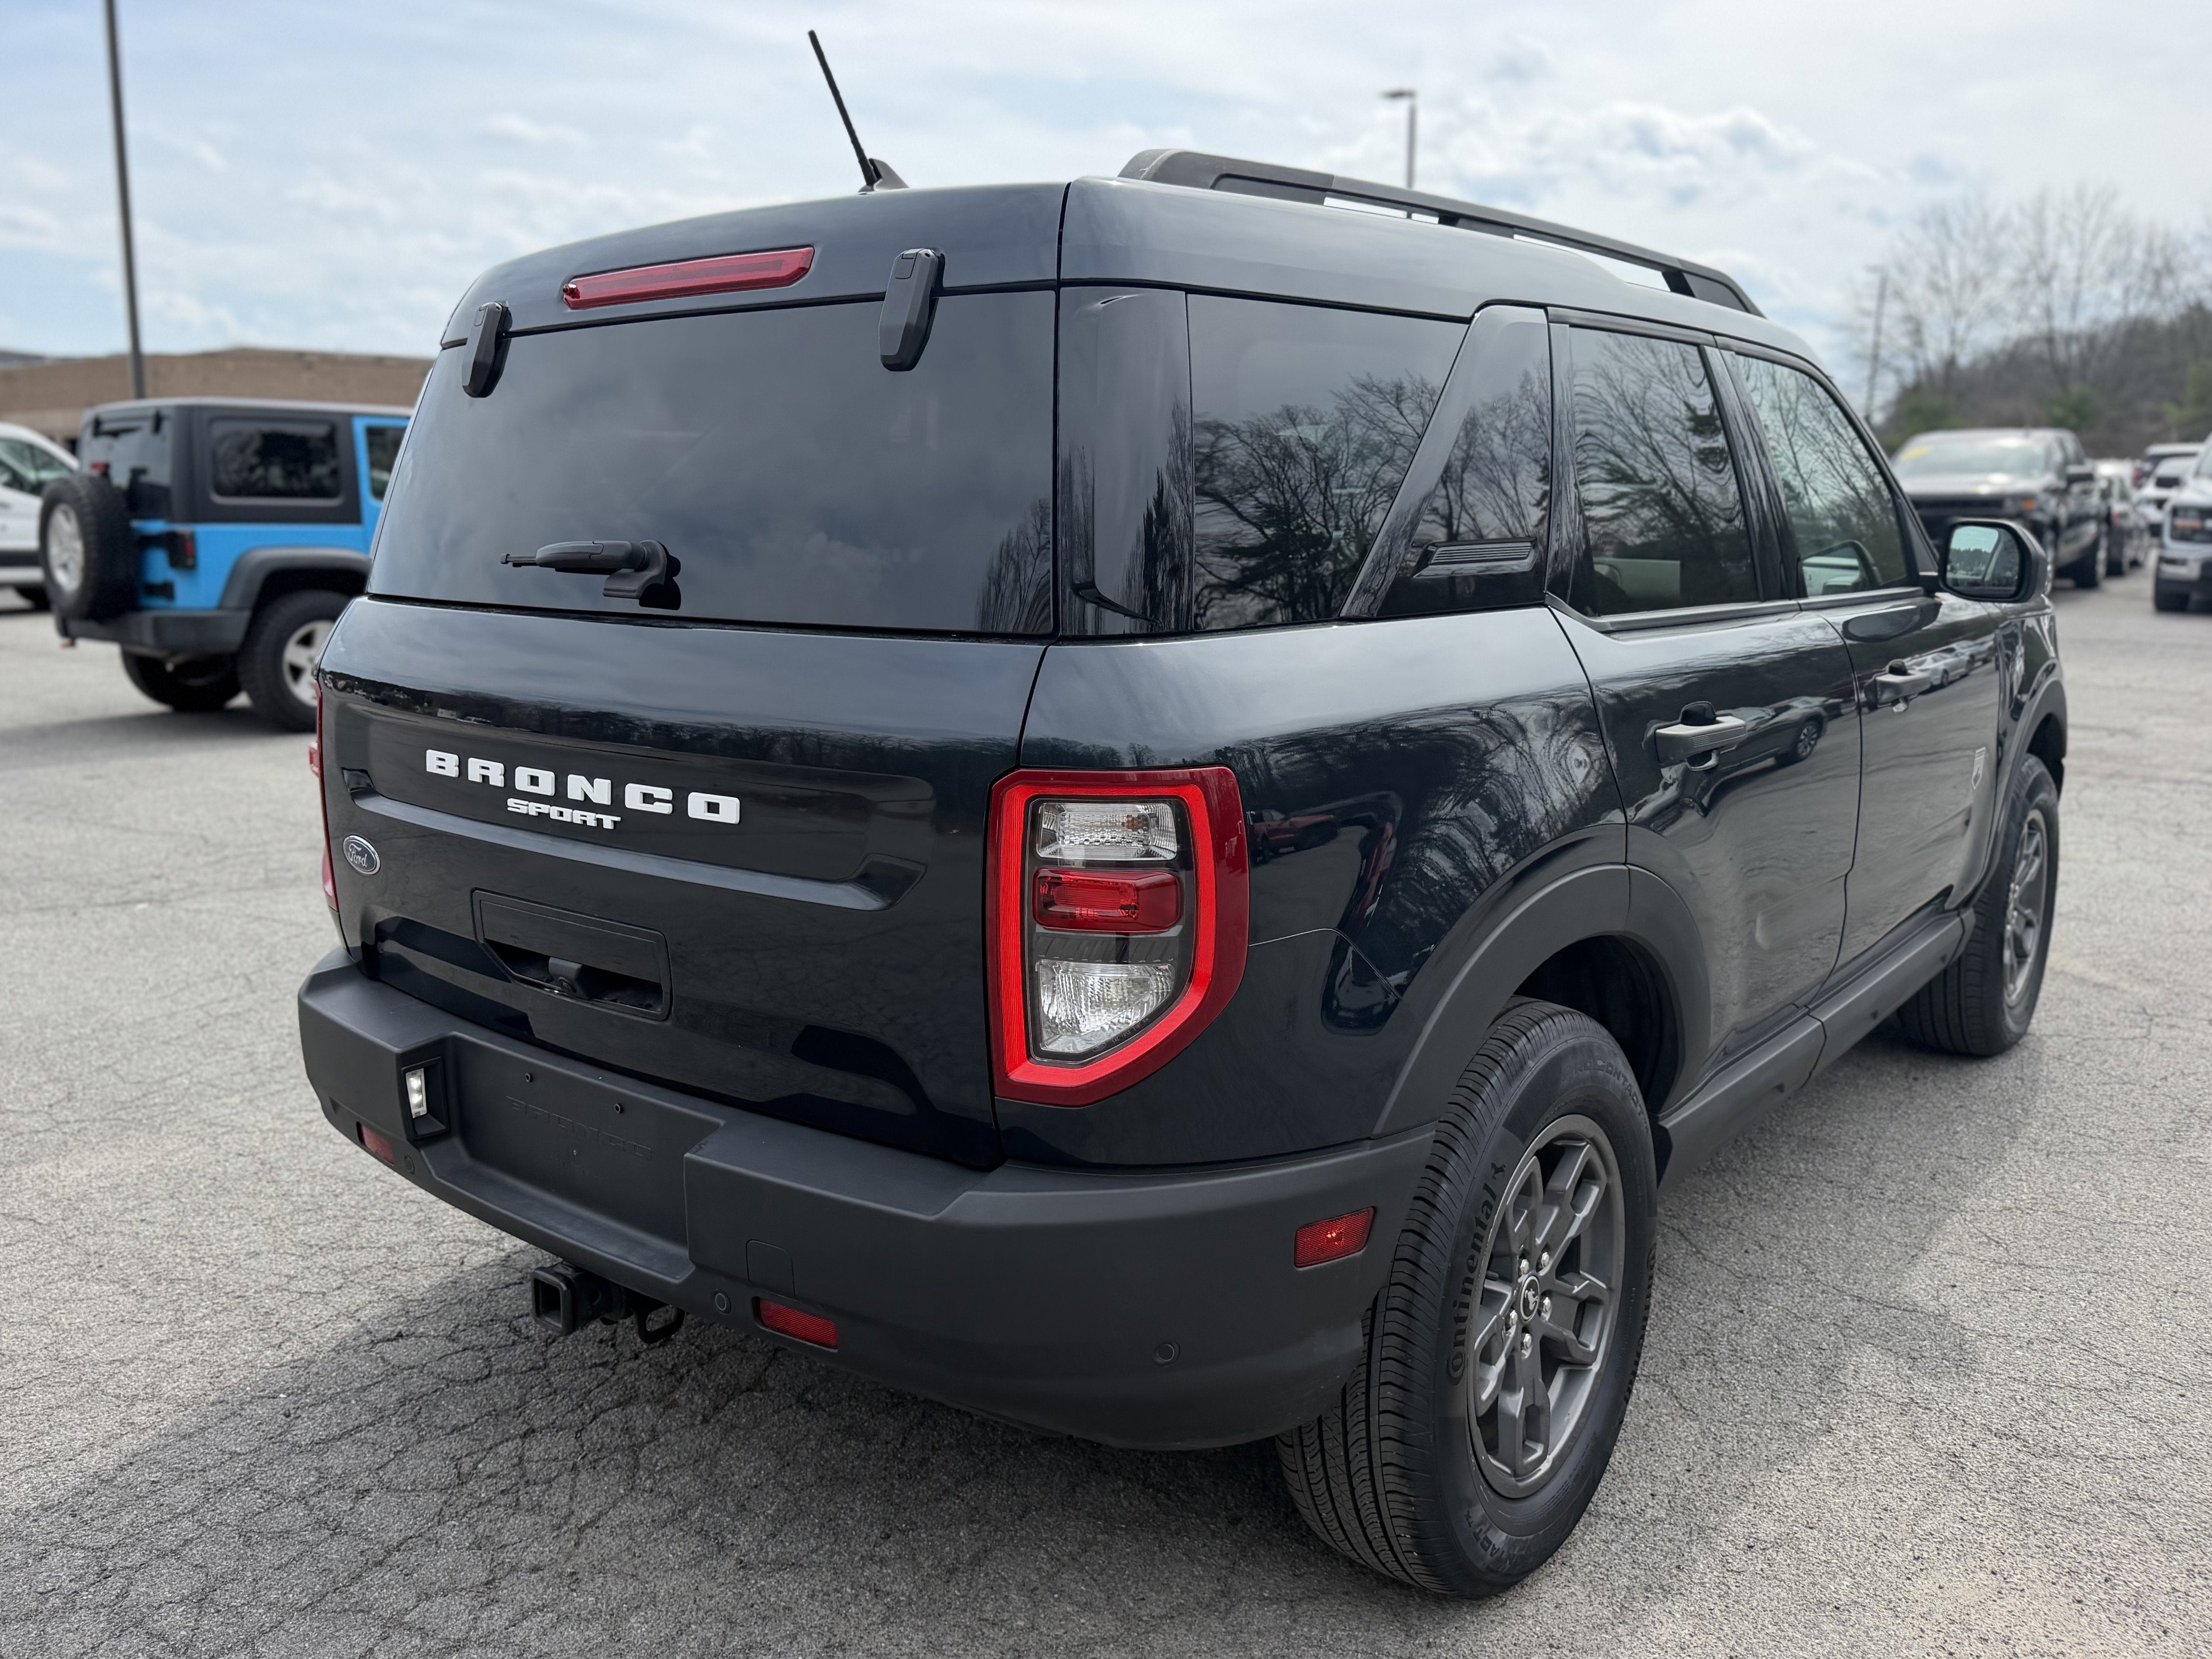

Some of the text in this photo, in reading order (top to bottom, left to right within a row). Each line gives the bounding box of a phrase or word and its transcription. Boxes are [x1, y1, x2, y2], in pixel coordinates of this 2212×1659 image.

[426, 749, 741, 824] BRONCO
[507, 798, 621, 830] SPORT
[348, 843, 368, 868] Ford
[1447, 1181, 1497, 1386] Continental
